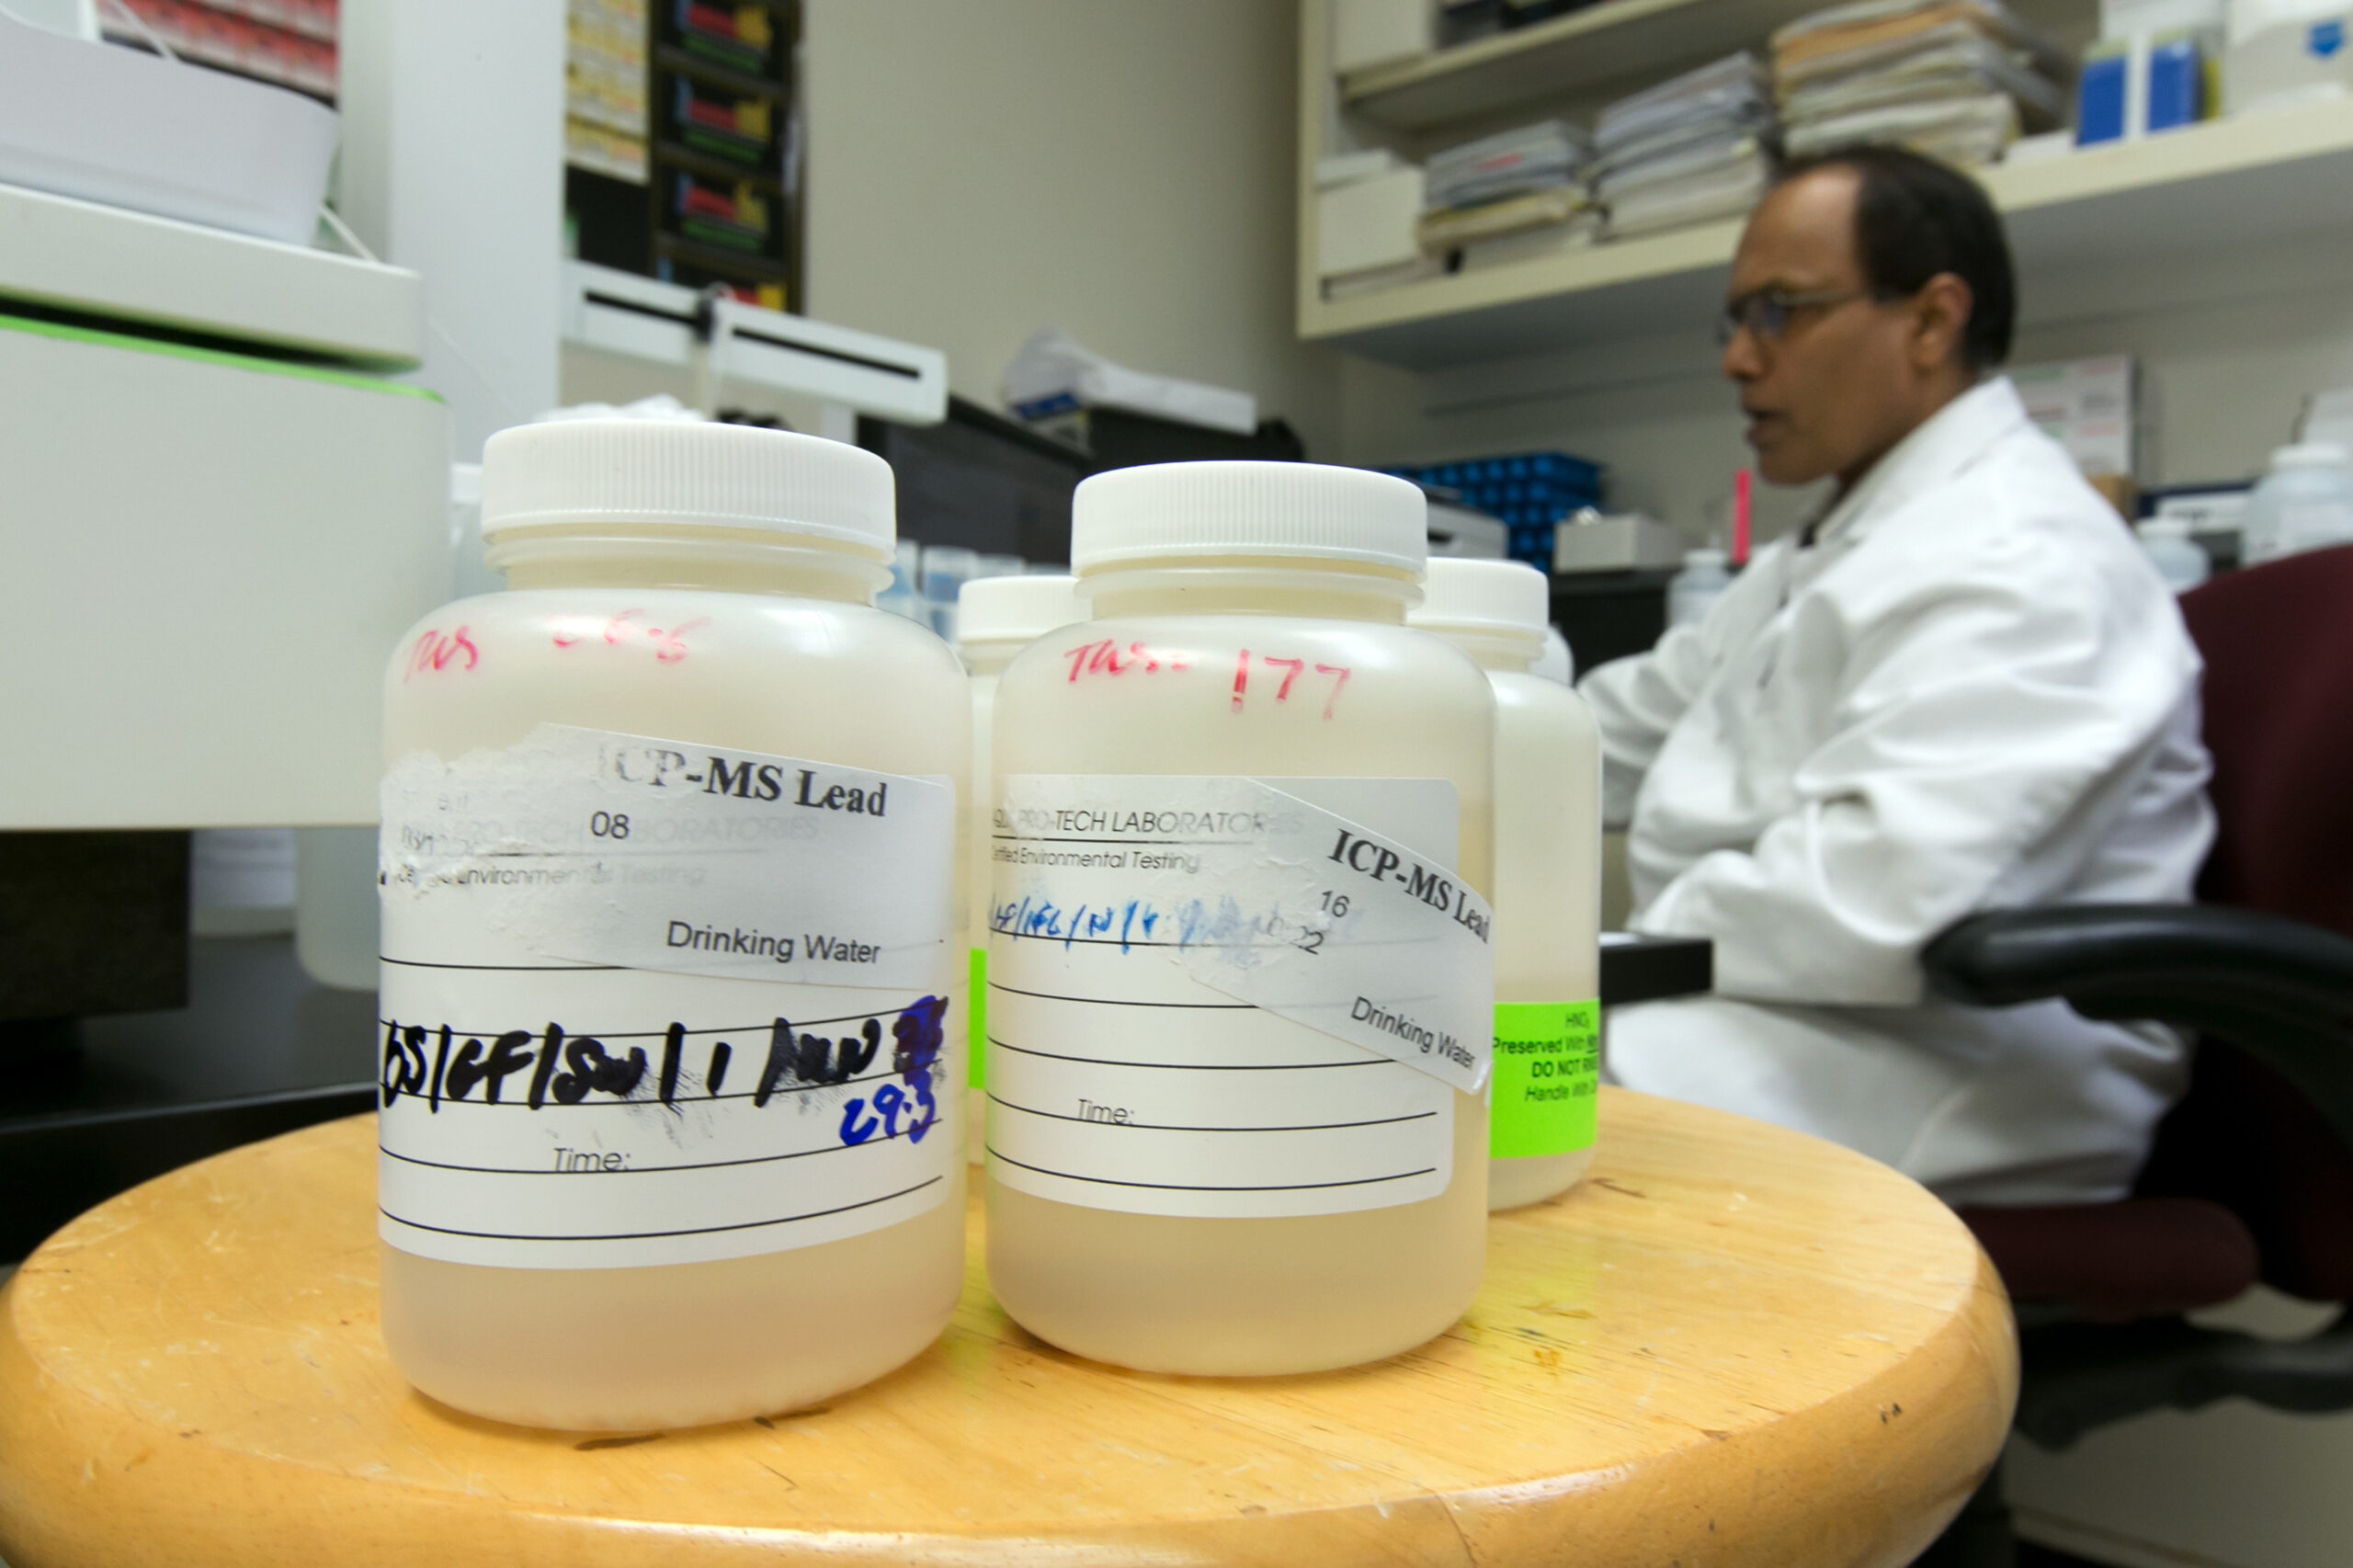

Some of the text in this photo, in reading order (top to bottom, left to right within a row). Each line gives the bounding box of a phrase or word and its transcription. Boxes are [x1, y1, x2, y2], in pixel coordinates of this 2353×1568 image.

[793, 769, 888, 817] Lead
[590, 810, 630, 839] 08
[1020, 846, 1126, 869] Environmental
[1131, 851, 1201, 874] Testing
[1327, 828, 1490, 944] ICP-MS Lead
[1321, 890, 1350, 918] 16
[665, 920, 881, 963] Drinking Water
[1350, 995, 1476, 1071] Drinking Water
[1492, 1036, 1563, 1054] Preserved
[1531, 1061, 1554, 1078] DO
[1557, 1059, 1580, 1076] NOT
[1077, 1097, 1136, 1127] Time:
[553, 1146, 631, 1173] Time:
